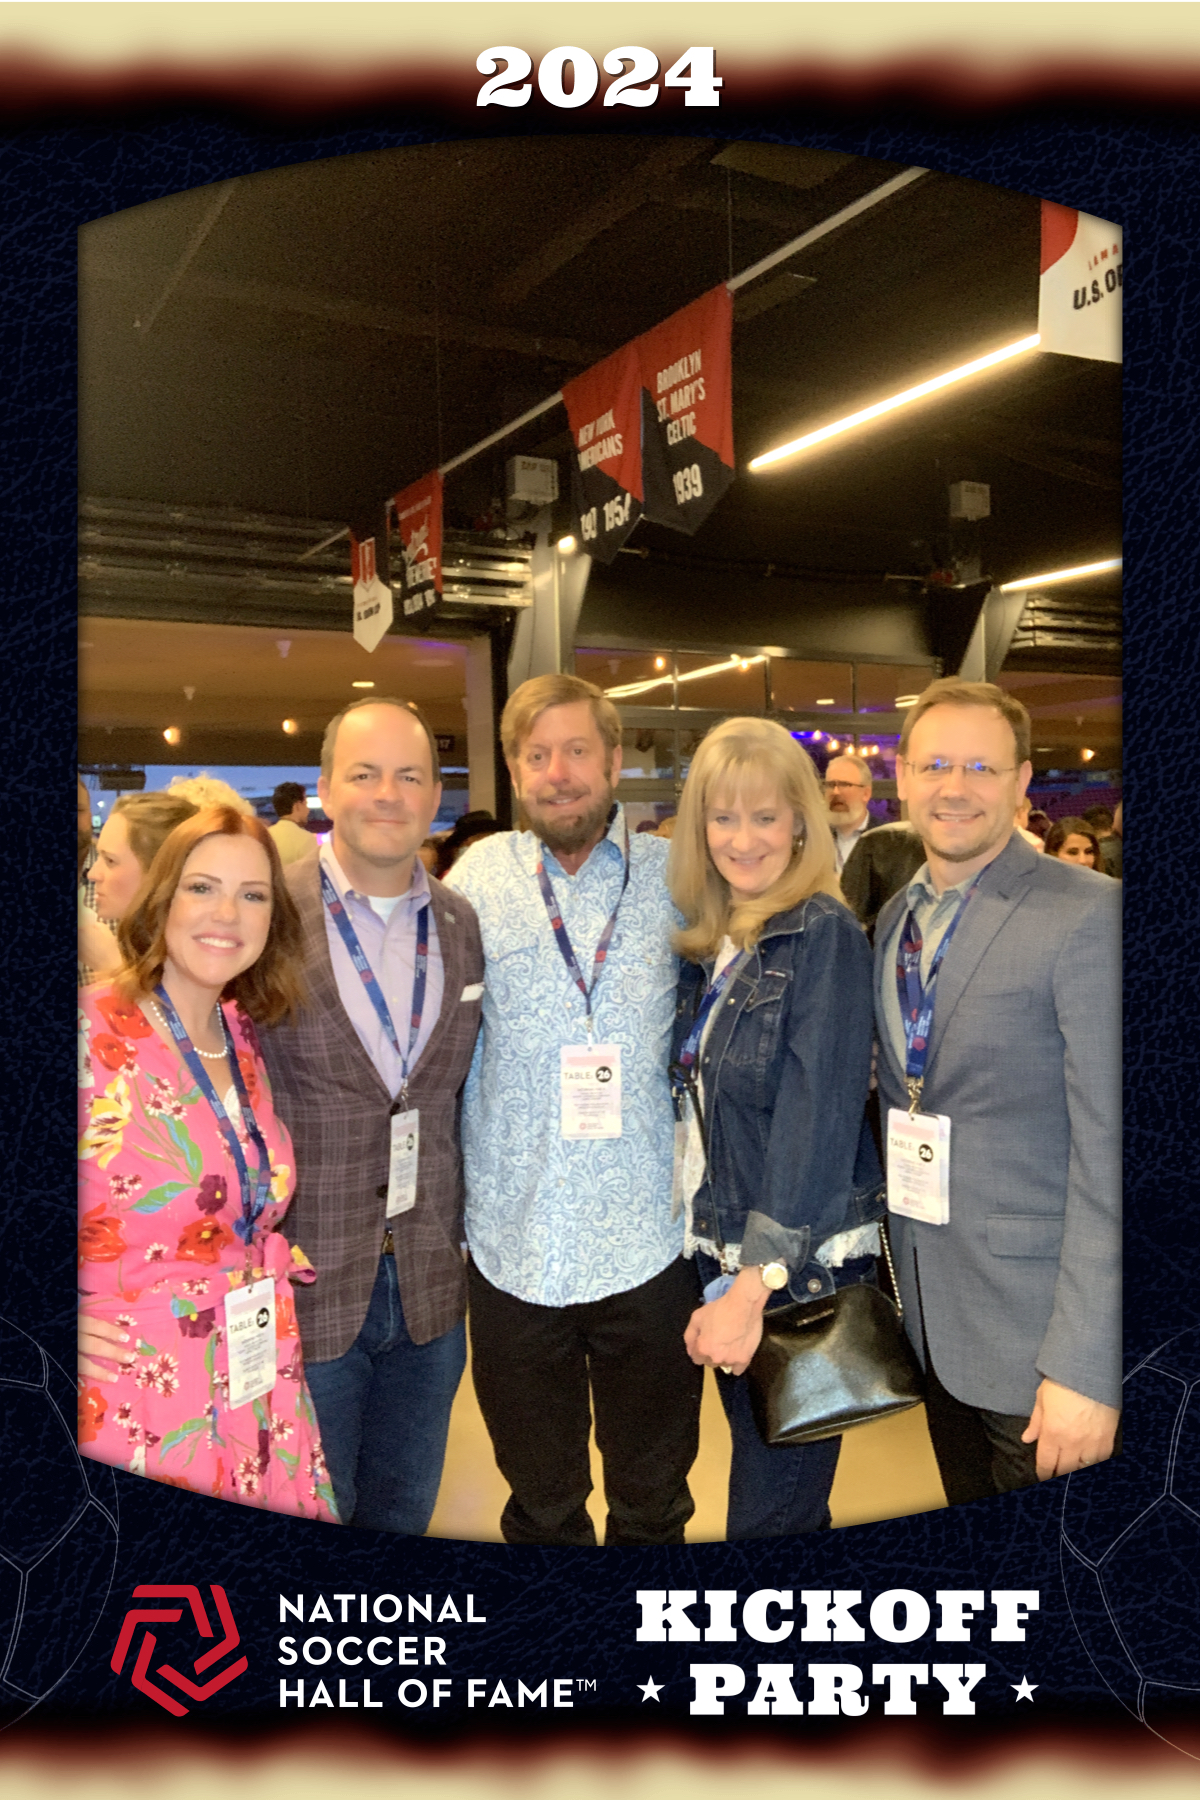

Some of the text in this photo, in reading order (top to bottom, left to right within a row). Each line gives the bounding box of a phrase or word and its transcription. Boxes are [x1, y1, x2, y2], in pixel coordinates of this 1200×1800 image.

[657, 348, 702, 394] BROOKLYN
[670, 377, 706, 415] MARY'S
[667, 411, 697, 446] CELTIC
[672, 463, 704, 505] 1939
